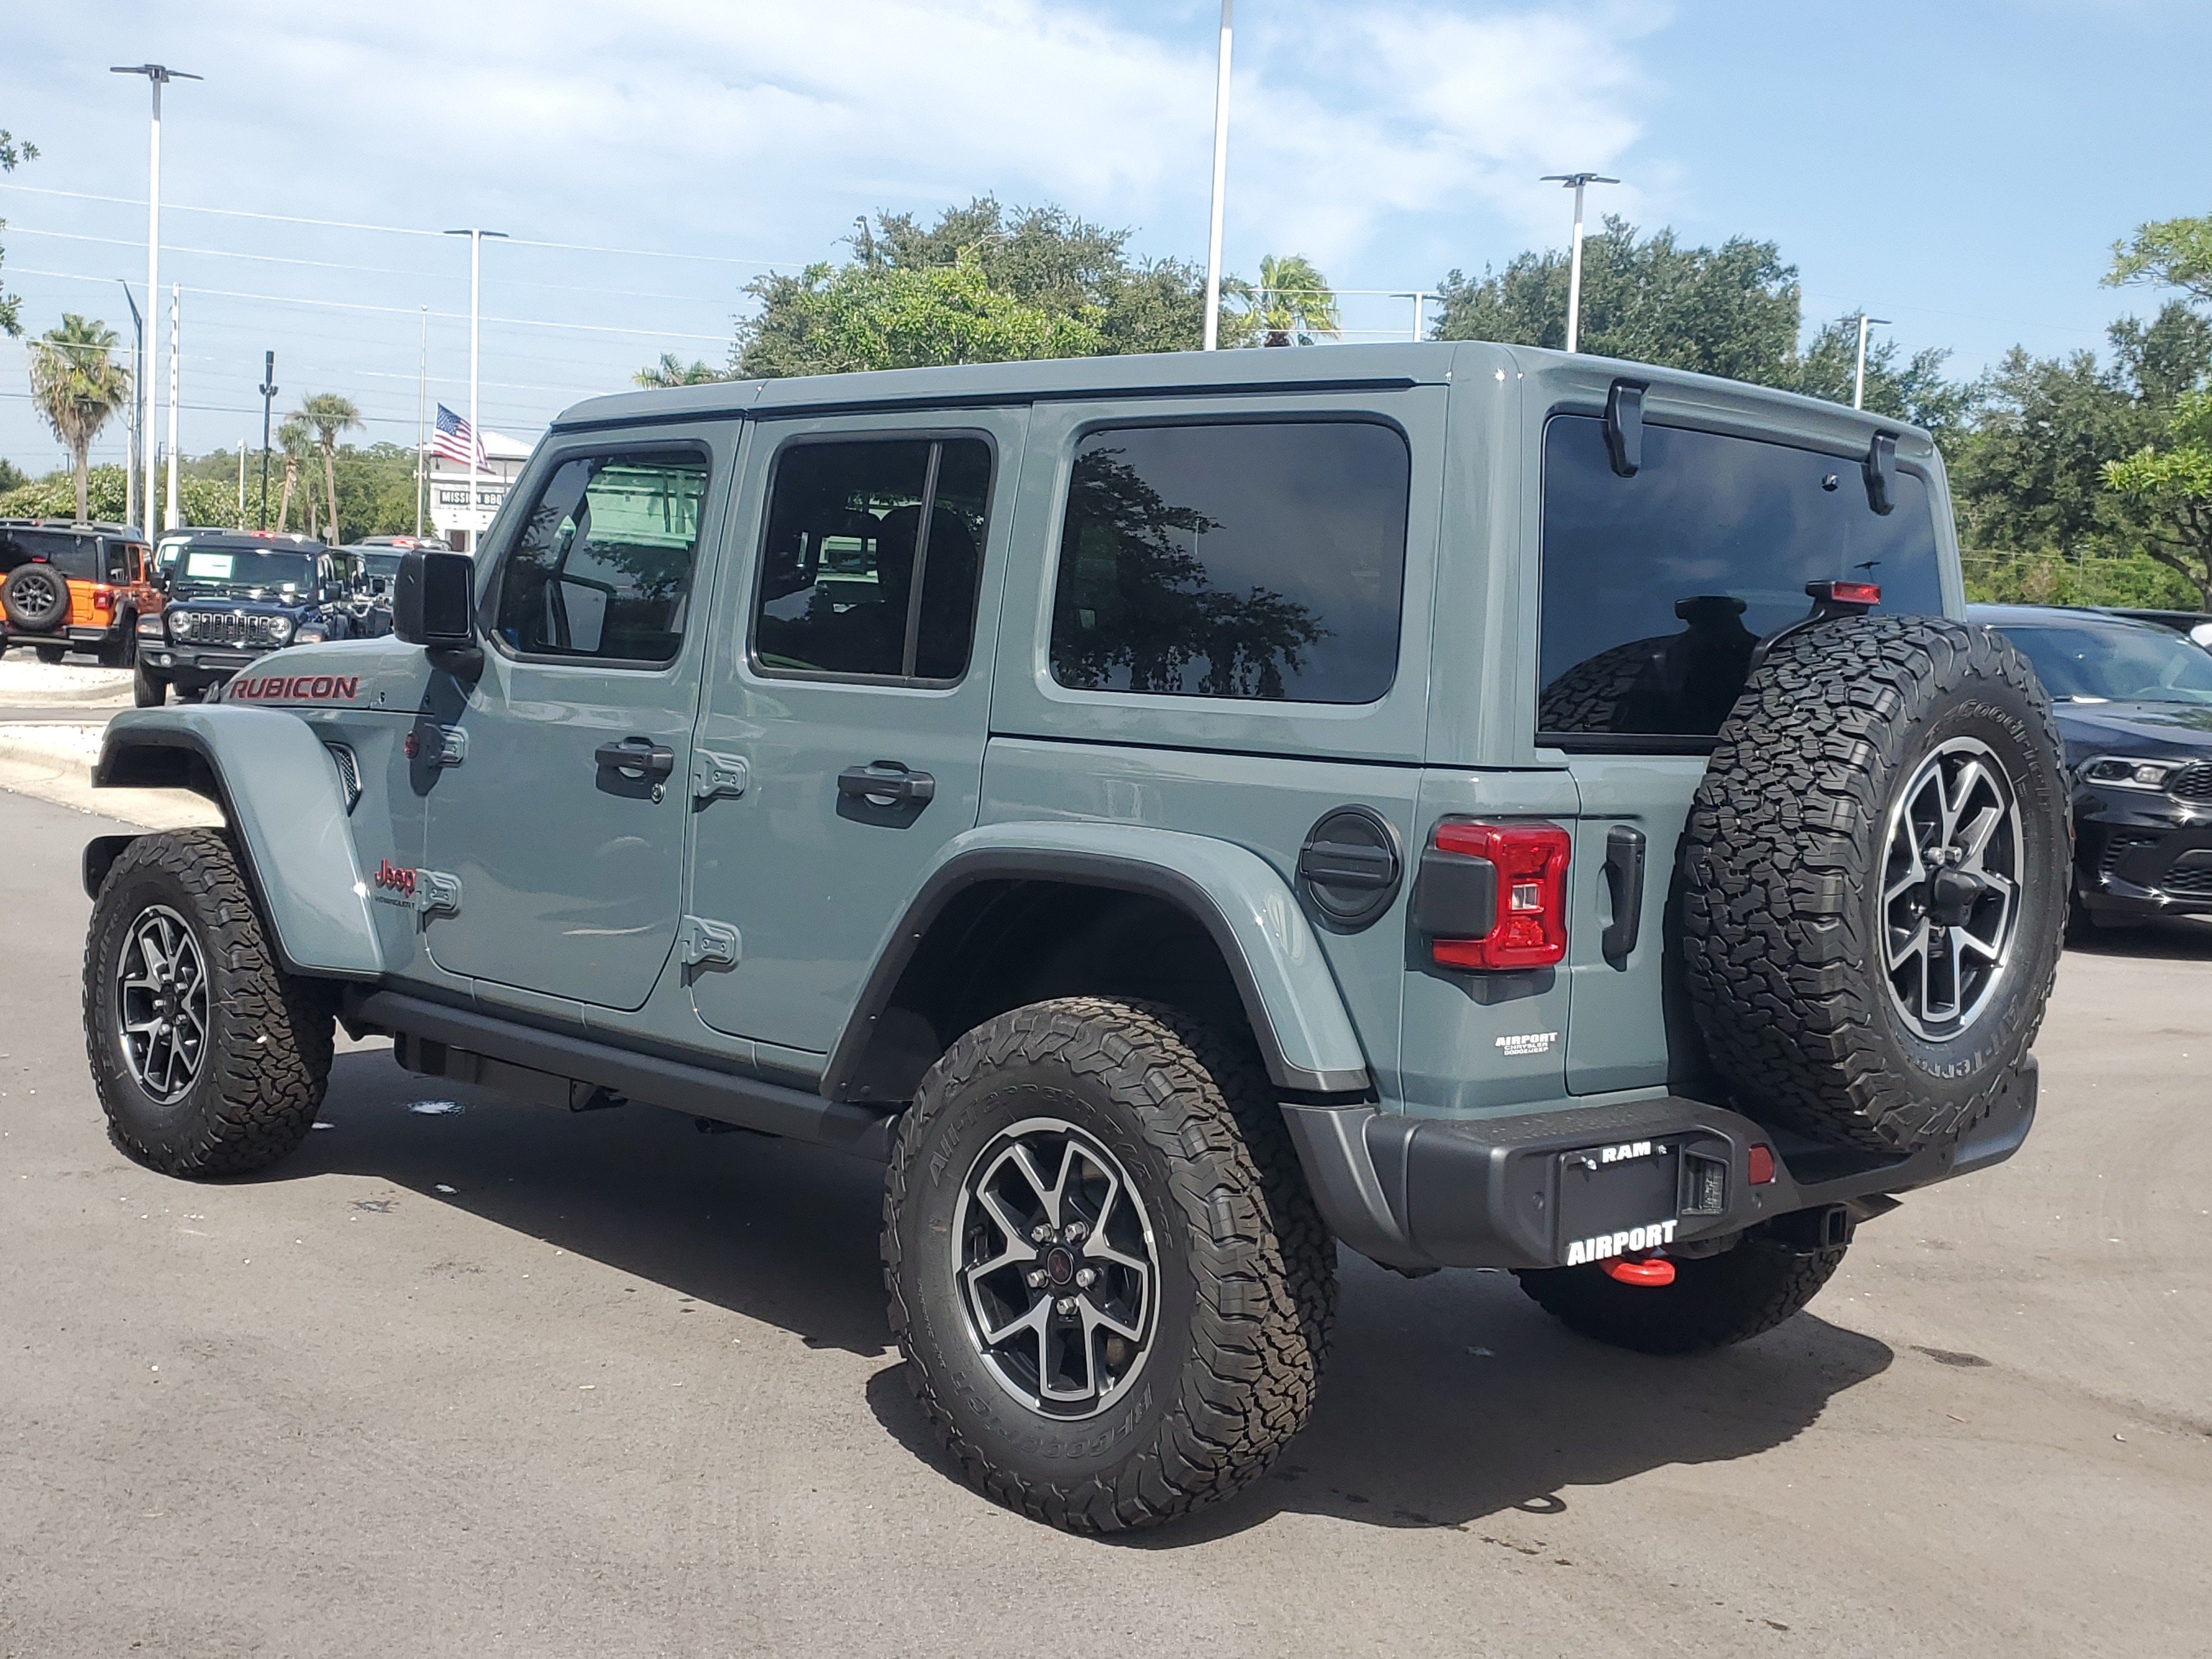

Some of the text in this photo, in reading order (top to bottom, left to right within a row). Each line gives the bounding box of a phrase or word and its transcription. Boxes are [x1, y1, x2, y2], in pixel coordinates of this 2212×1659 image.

[442, 492, 481, 503] MISSIN
[228, 675, 360, 699] RUBICON
[375, 858, 415, 899] Jeep
[1495, 1032, 1558, 1046] AIRPORT
[1602, 1142, 1651, 1163] RAM
[1567, 1220, 1678, 1266] AIRPORT
